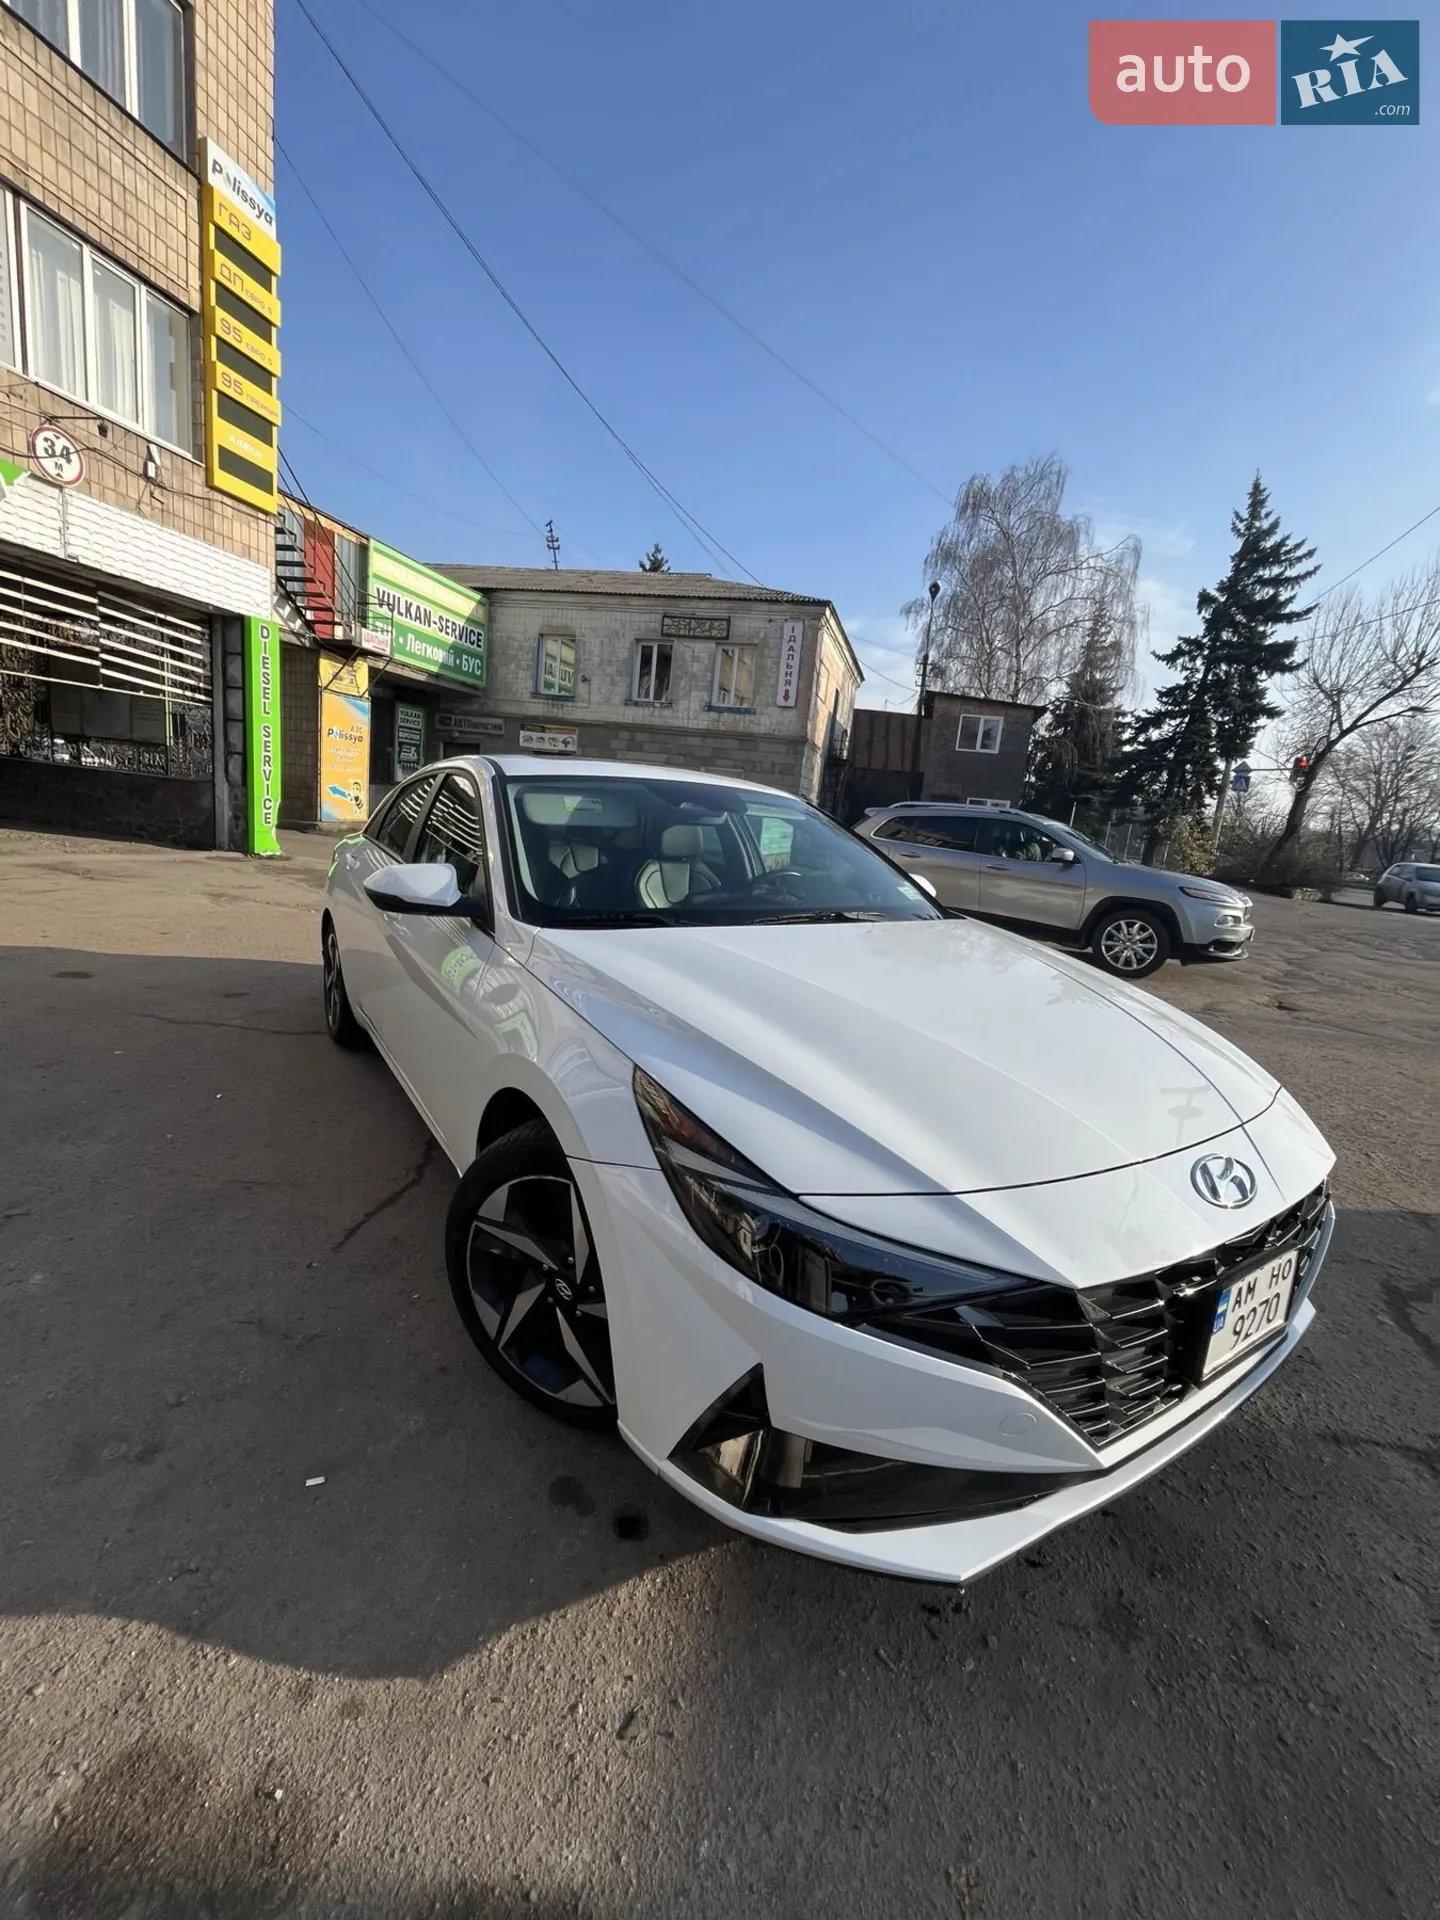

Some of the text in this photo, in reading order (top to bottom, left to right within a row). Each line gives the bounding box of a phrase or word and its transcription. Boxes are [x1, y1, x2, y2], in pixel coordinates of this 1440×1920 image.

[212, 158, 272, 226] Polissya
[219, 202, 251, 241] ГАЗ
[220, 262, 243, 292] ДП
[220, 317, 243, 344] 95
[221, 371, 243, 397] 95
[376, 587, 483, 649] VULKAN-SERVICE
[406, 633, 454, 667] Легковий
[461, 655, 482, 676] БУС
[260, 624, 273, 825] DIESEL SERVICE
[327, 728, 364, 744] Polissya
[1232, 1258, 1293, 1313] AM HO
[1231, 1293, 1281, 1350] 9270
